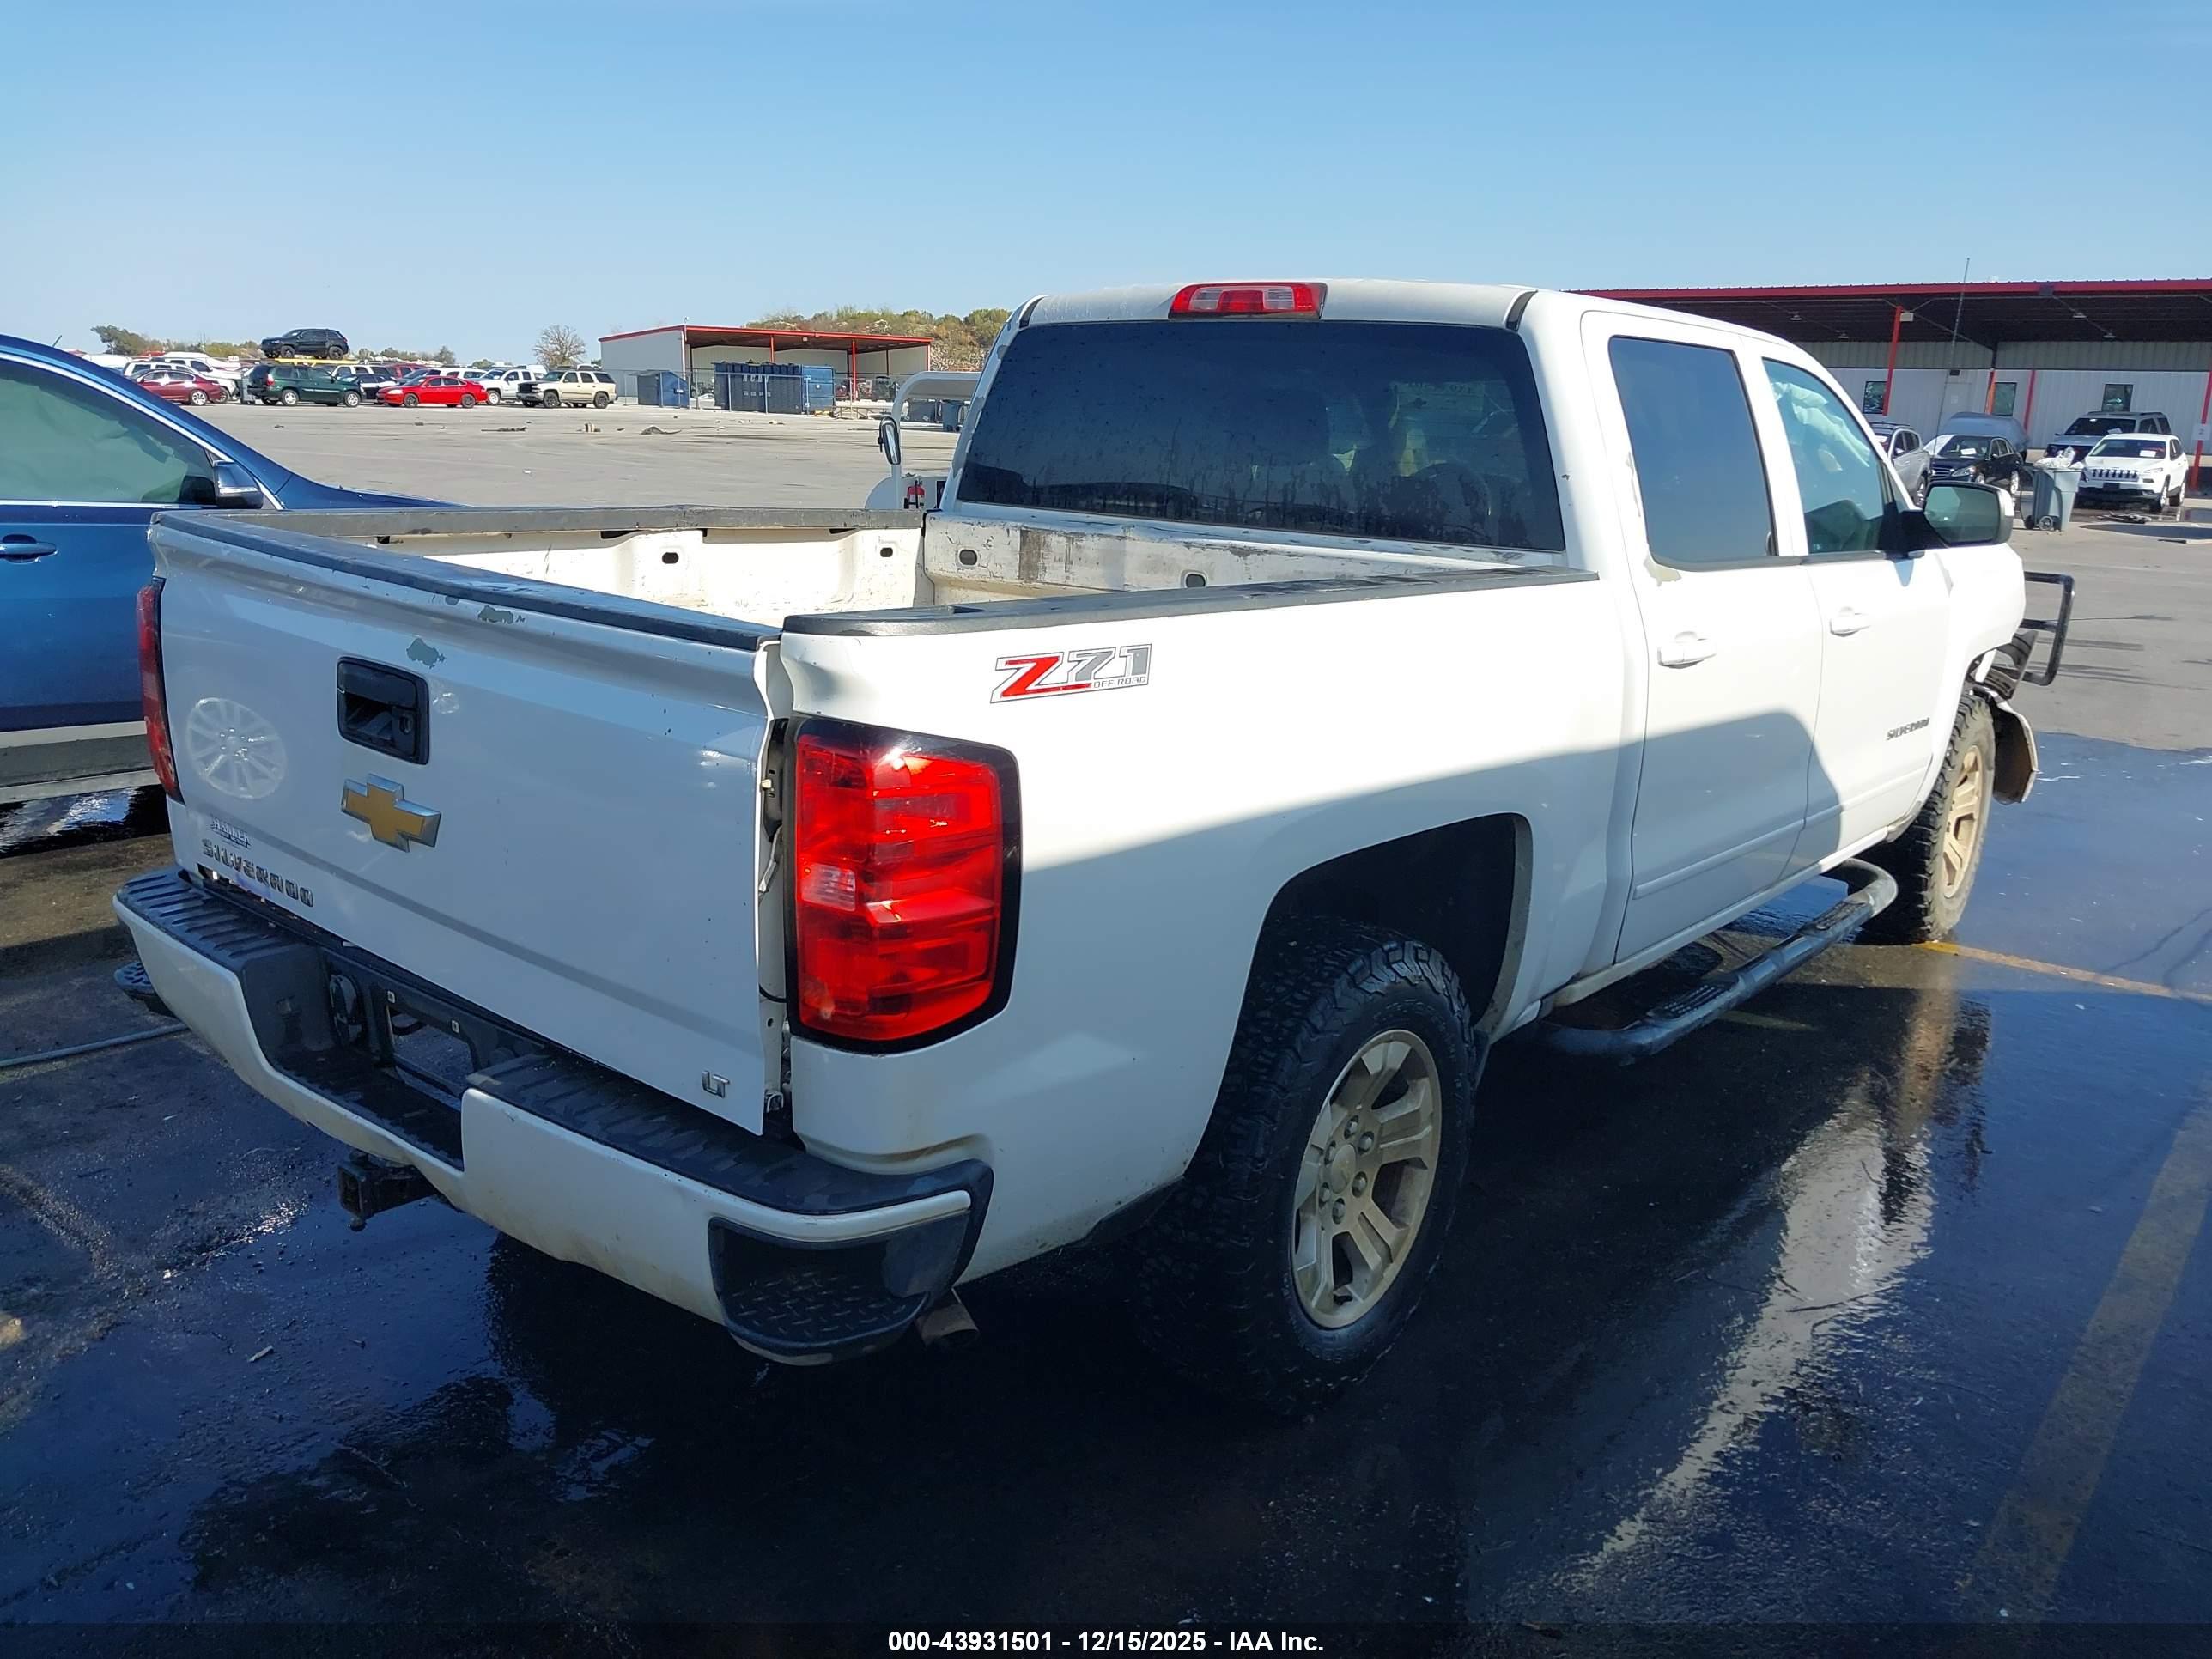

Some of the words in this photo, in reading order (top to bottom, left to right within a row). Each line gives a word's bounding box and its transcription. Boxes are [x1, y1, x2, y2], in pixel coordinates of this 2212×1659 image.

[991, 644, 1152, 703] Z71
[1093, 680, 1115, 689] OFF
[1117, 676, 1147, 686] ROAD
[201, 838, 314, 908] SILVERADO
[702, 1070, 730, 1099] LT
